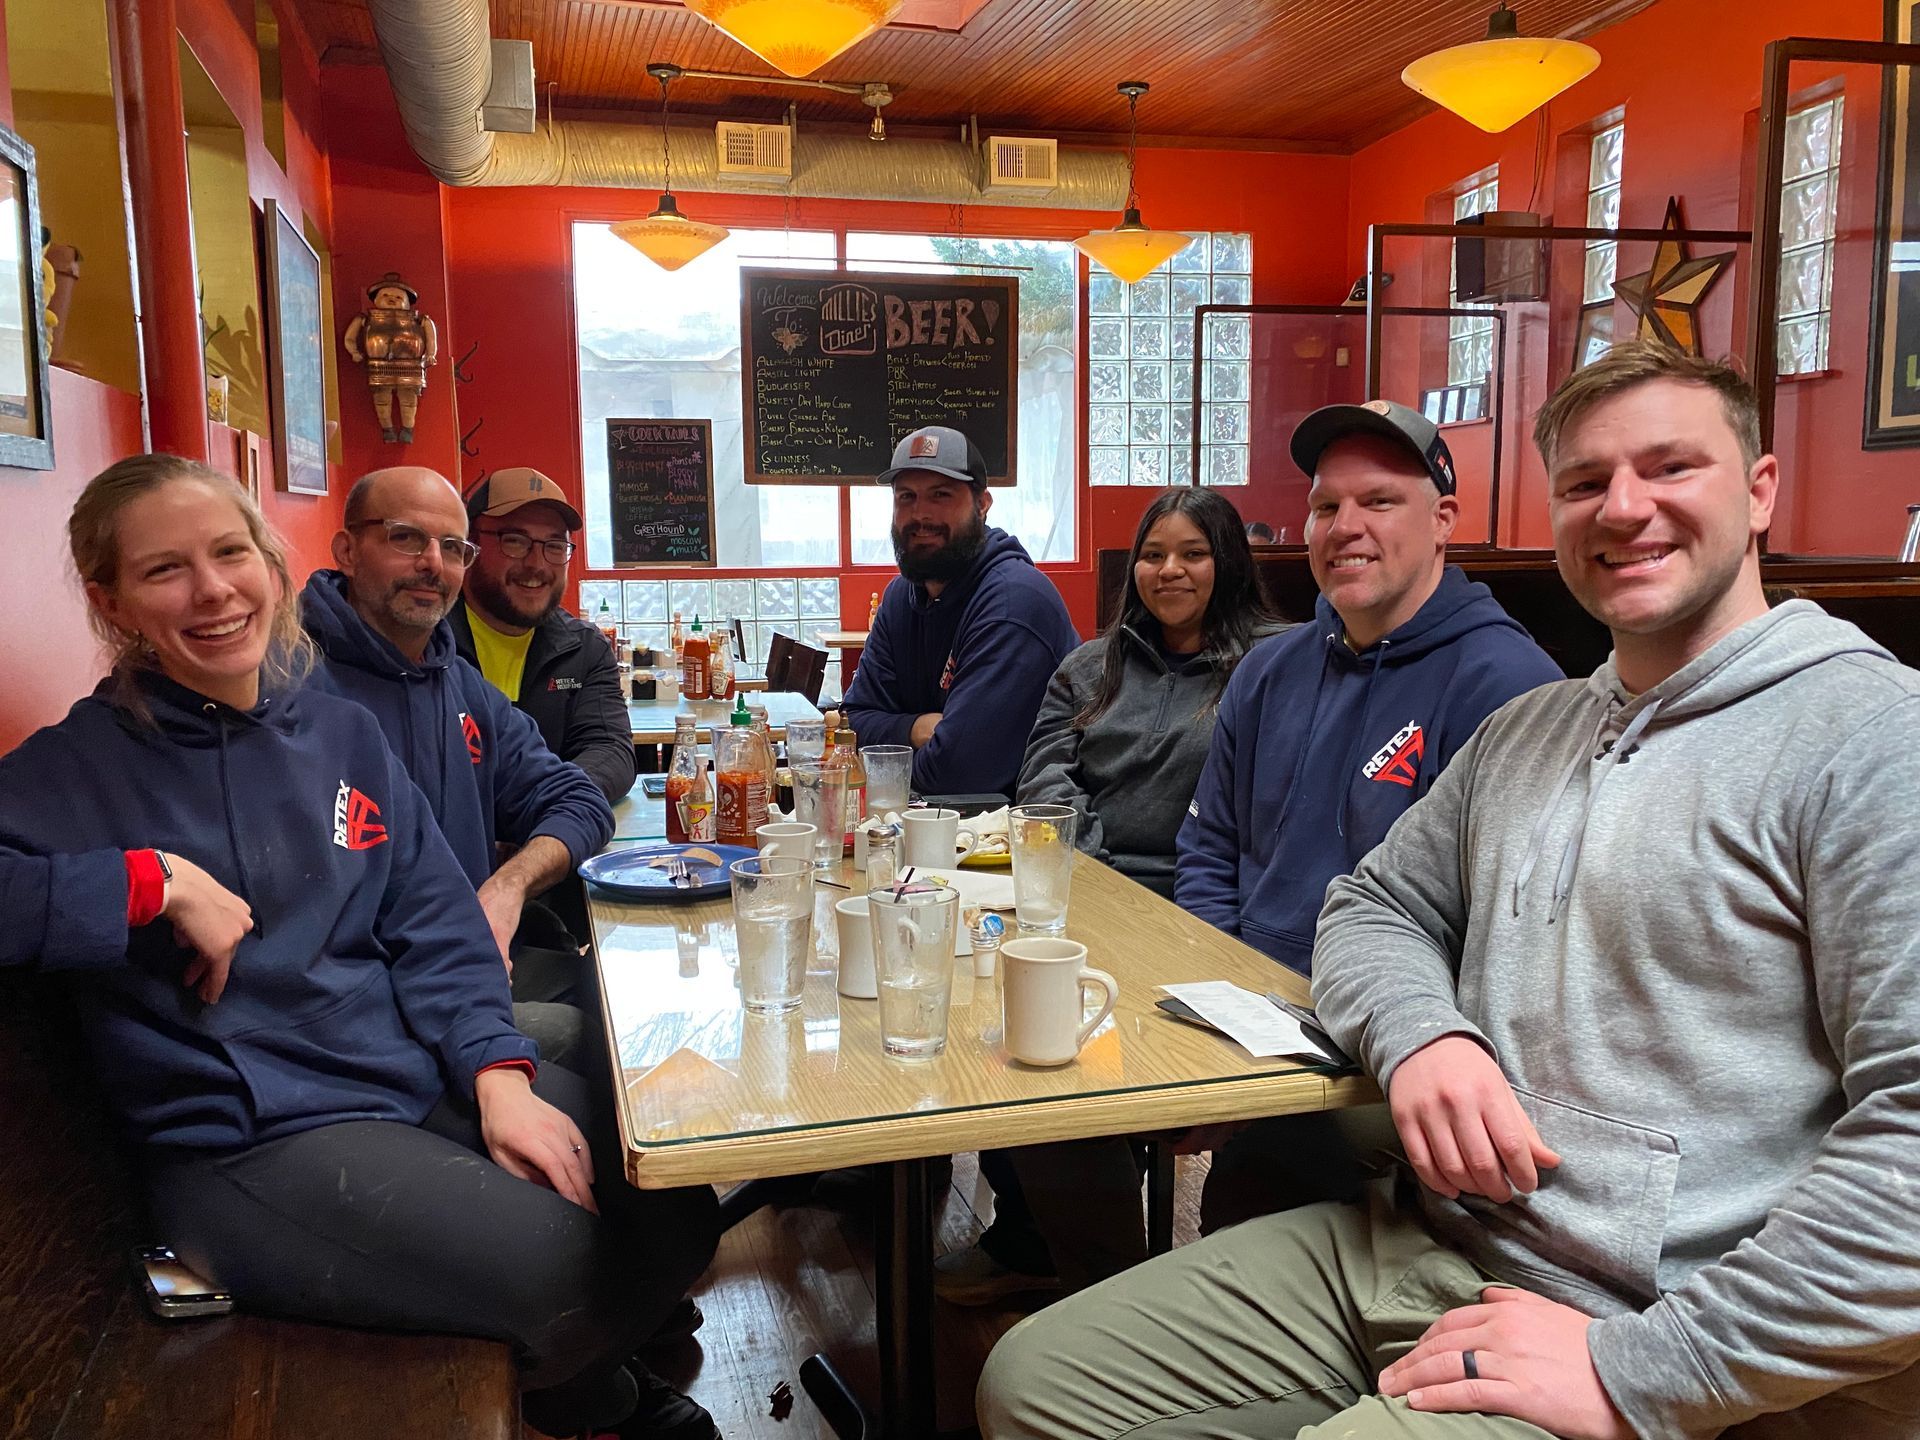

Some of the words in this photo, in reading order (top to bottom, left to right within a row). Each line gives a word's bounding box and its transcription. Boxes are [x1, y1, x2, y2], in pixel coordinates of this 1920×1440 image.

[757, 285, 818, 307] Welcome
[883, 295, 1000, 349] BEER!
[825, 323, 871, 351] Diner
[807, 359, 835, 369] WHITE
[795, 368, 821, 378] LIGHT
[887, 366, 909, 379] PBR
[757, 379, 811, 392] BUDWEISER
[888, 422, 918, 436] TECAT
[761, 450, 811, 464] GUINNESS
[619, 482, 649, 492] MIMOSA
[1362, 719, 1421, 779] RETEX
[333, 779, 350, 849] RETEX
